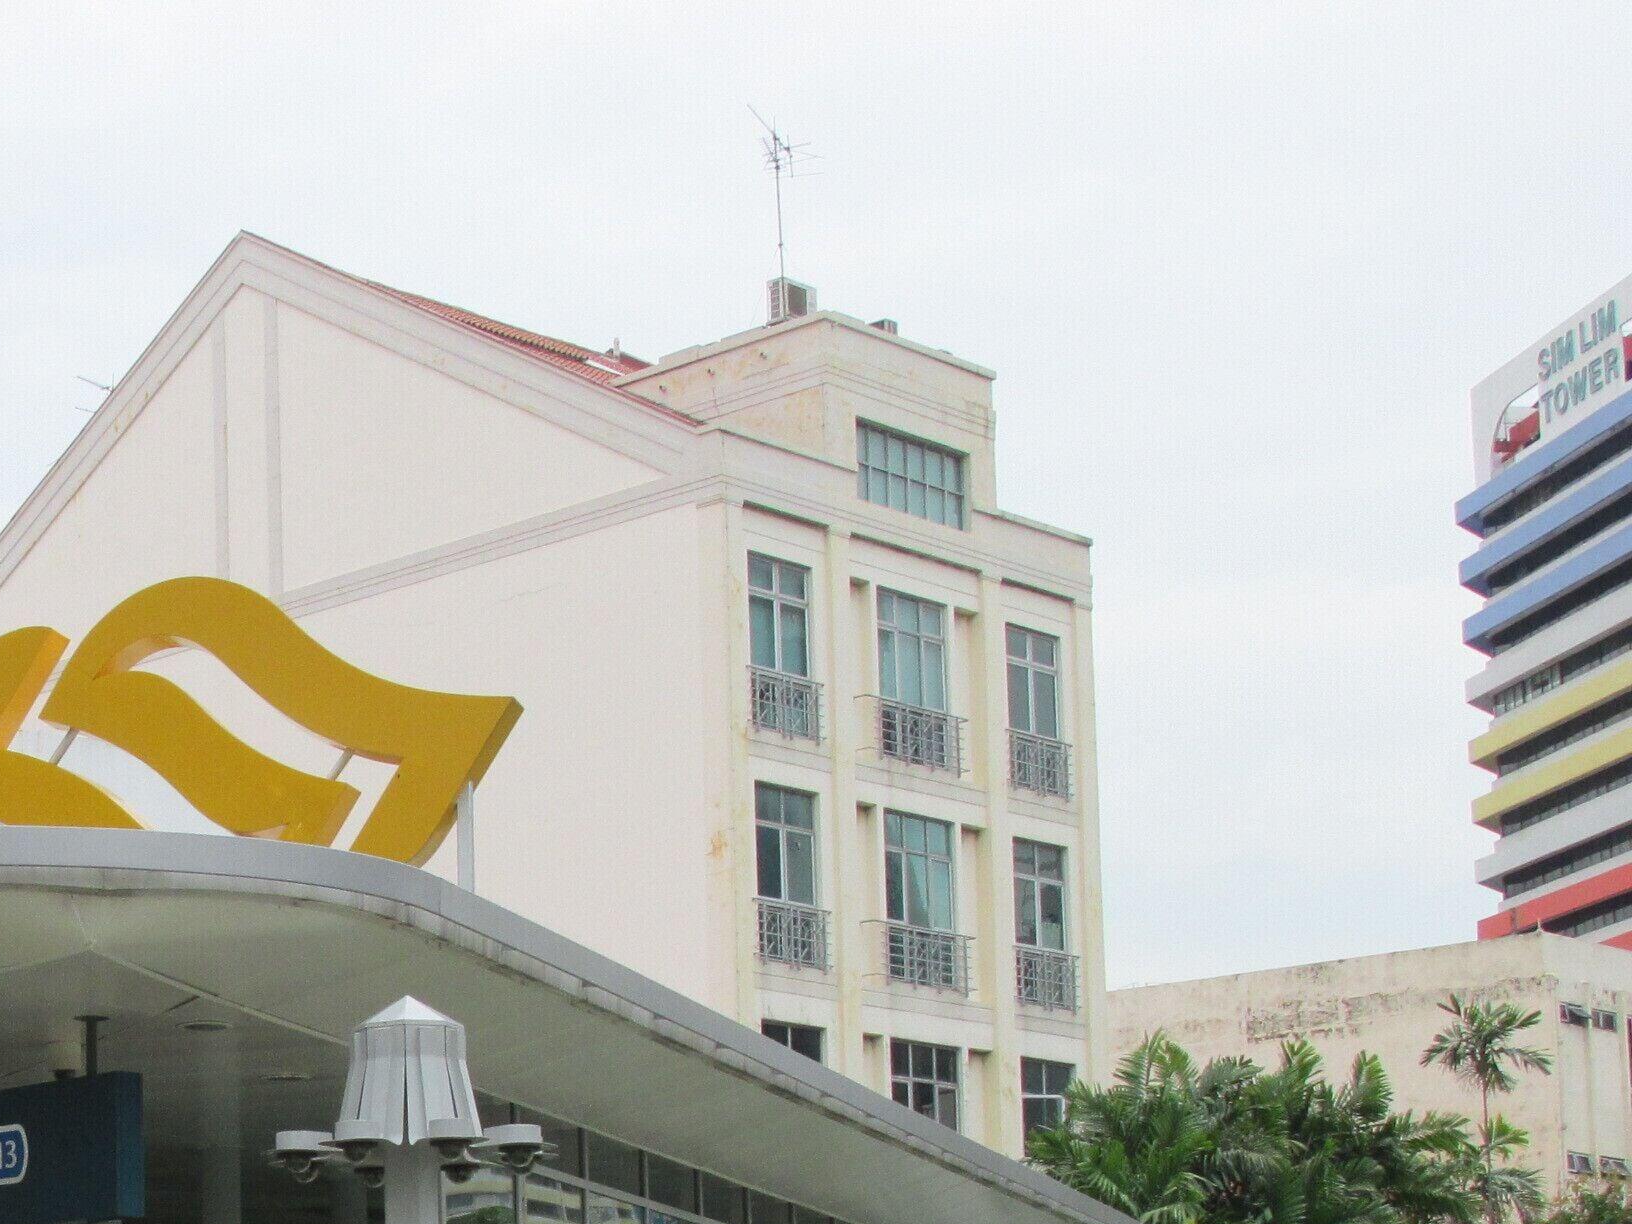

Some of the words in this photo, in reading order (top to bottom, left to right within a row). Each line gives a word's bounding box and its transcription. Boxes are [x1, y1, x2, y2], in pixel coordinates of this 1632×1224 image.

[1537, 330, 1575, 381] SIM
[1579, 300, 1616, 353] LIM
[1540, 347, 1619, 424] TOWER
